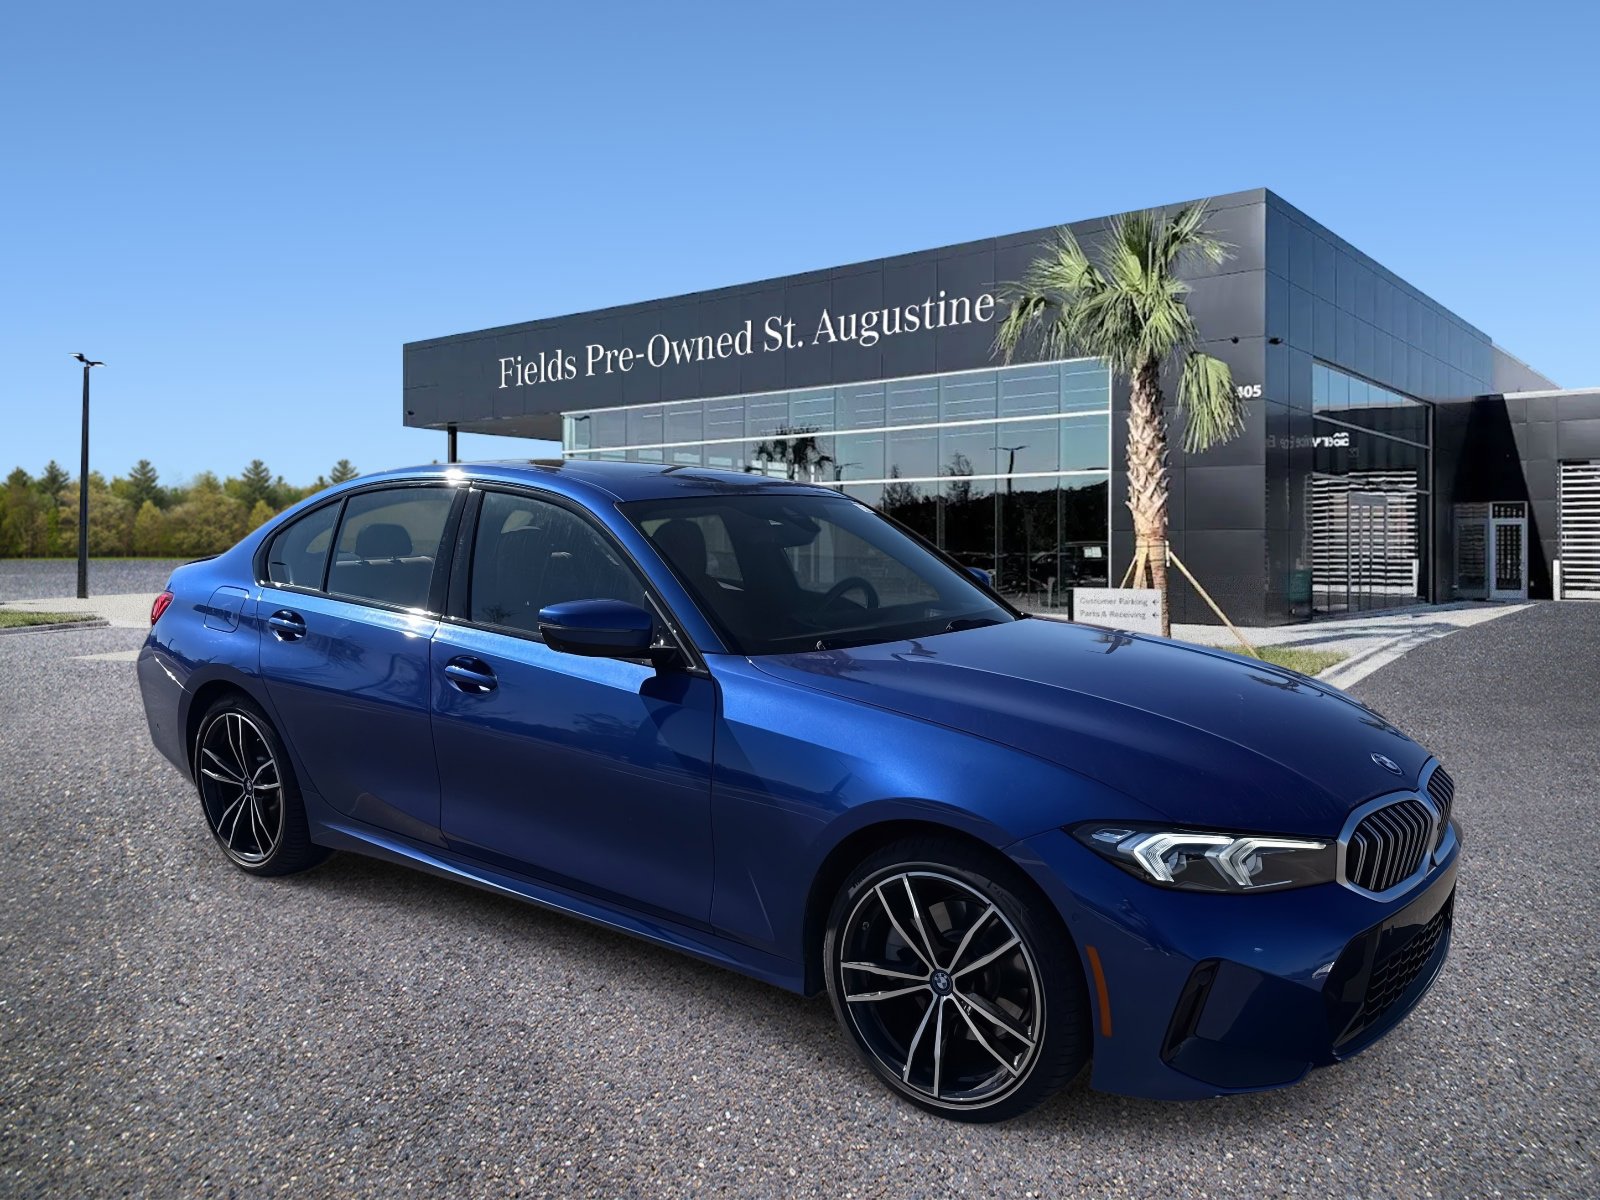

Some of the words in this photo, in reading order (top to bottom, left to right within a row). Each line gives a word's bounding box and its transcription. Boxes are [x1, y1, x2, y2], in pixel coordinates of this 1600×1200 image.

[498, 349, 577, 389] Fields
[585, 320, 754, 377] Pre-Owned
[763, 315, 804, 352] St.
[812, 290, 995, 347] Augustine
[1080, 597, 1117, 605] Customer
[1119, 597, 1149, 607] Parking
[1080, 609, 1100, 617] Parts
[1109, 610, 1146, 619] Receiving
